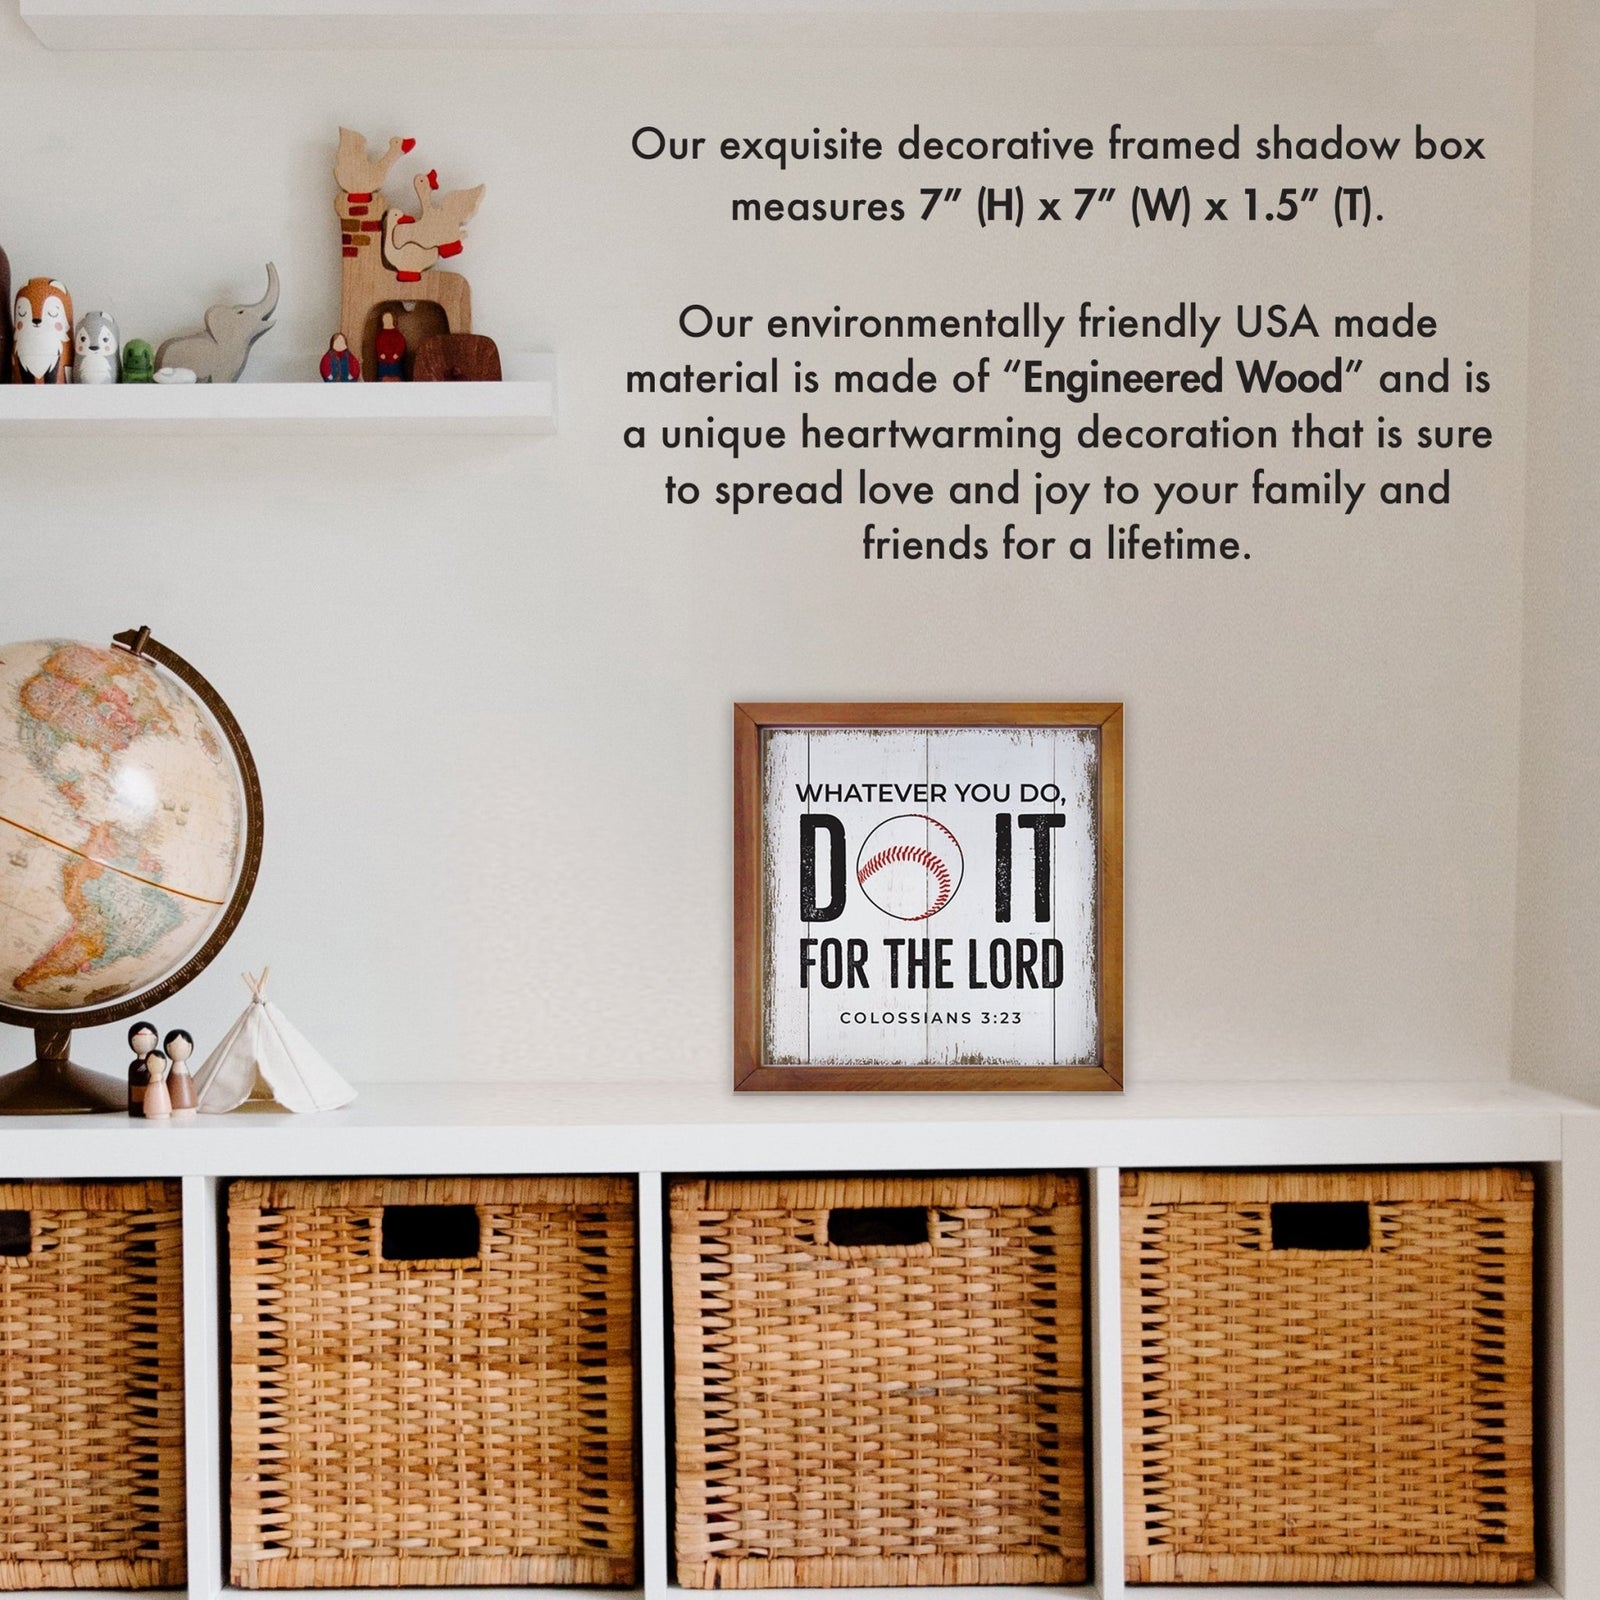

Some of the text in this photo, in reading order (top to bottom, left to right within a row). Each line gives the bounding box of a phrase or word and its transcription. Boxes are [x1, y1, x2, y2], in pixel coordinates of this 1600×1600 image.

[796, 784, 1066, 806] WHATEVER YOU DO,
[995, 813, 1066, 923] IT
[800, 938, 1064, 989] FOR THE LORD
[840, 1012, 1021, 1024] COLOSSIANS 3:23
